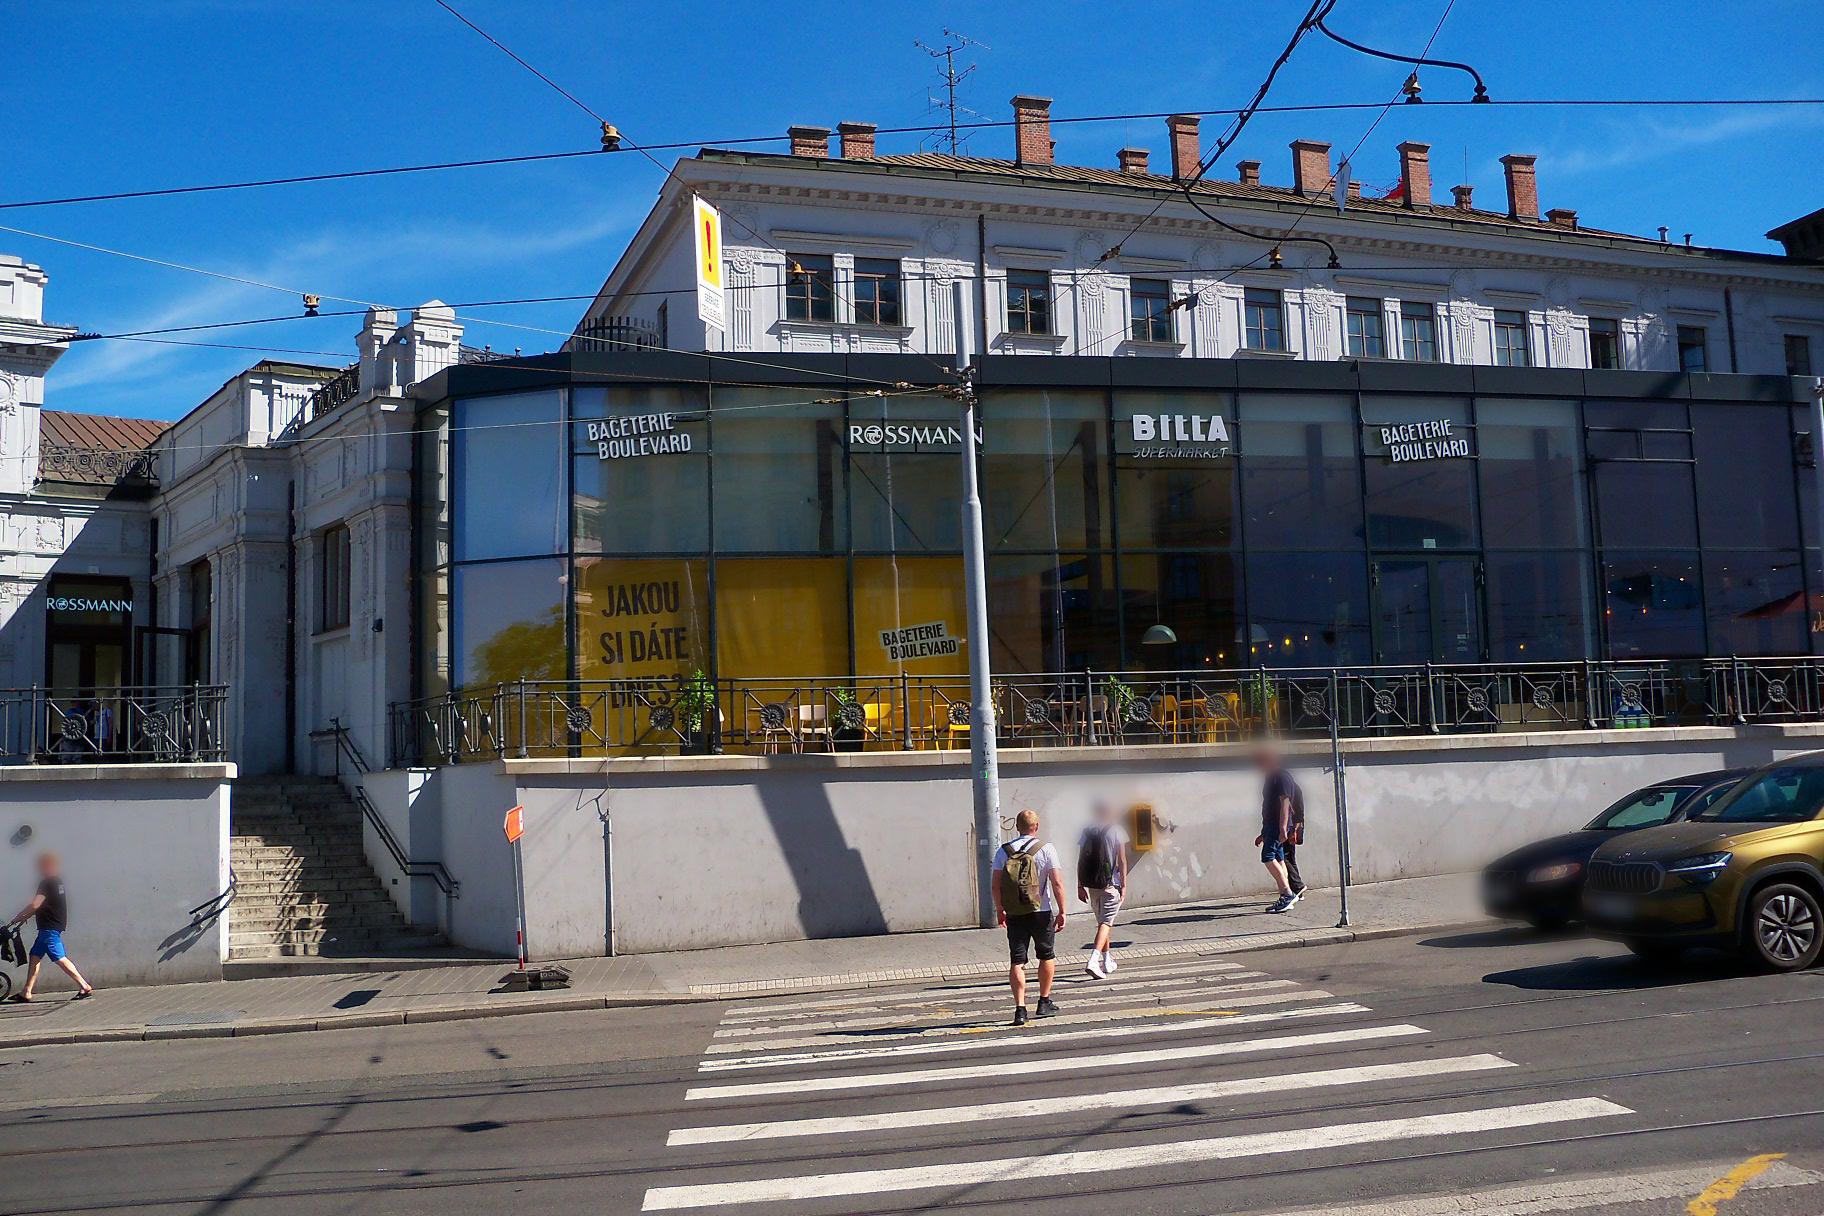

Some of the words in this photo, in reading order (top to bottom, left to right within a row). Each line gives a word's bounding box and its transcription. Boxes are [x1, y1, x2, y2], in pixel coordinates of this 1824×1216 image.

[587, 412, 674, 441] BAGETERIE
[1132, 414, 1229, 442] BILLA
[1381, 419, 1453, 445] BAGETERIE
[598, 433, 691, 460] BOULEVARD
[1133, 446, 1229, 459] SUPERMARKET
[1391, 439, 1469, 462] BOULEVARD
[46, 597, 133, 613] ROSSMANN
[601, 580, 680, 618] JAKOU
[600, 631, 624, 664] SI
[630, 622, 689, 662] DÁTE
[882, 624, 945, 647] BAGETERIE
[890, 639, 957, 660] BOULEVARD
